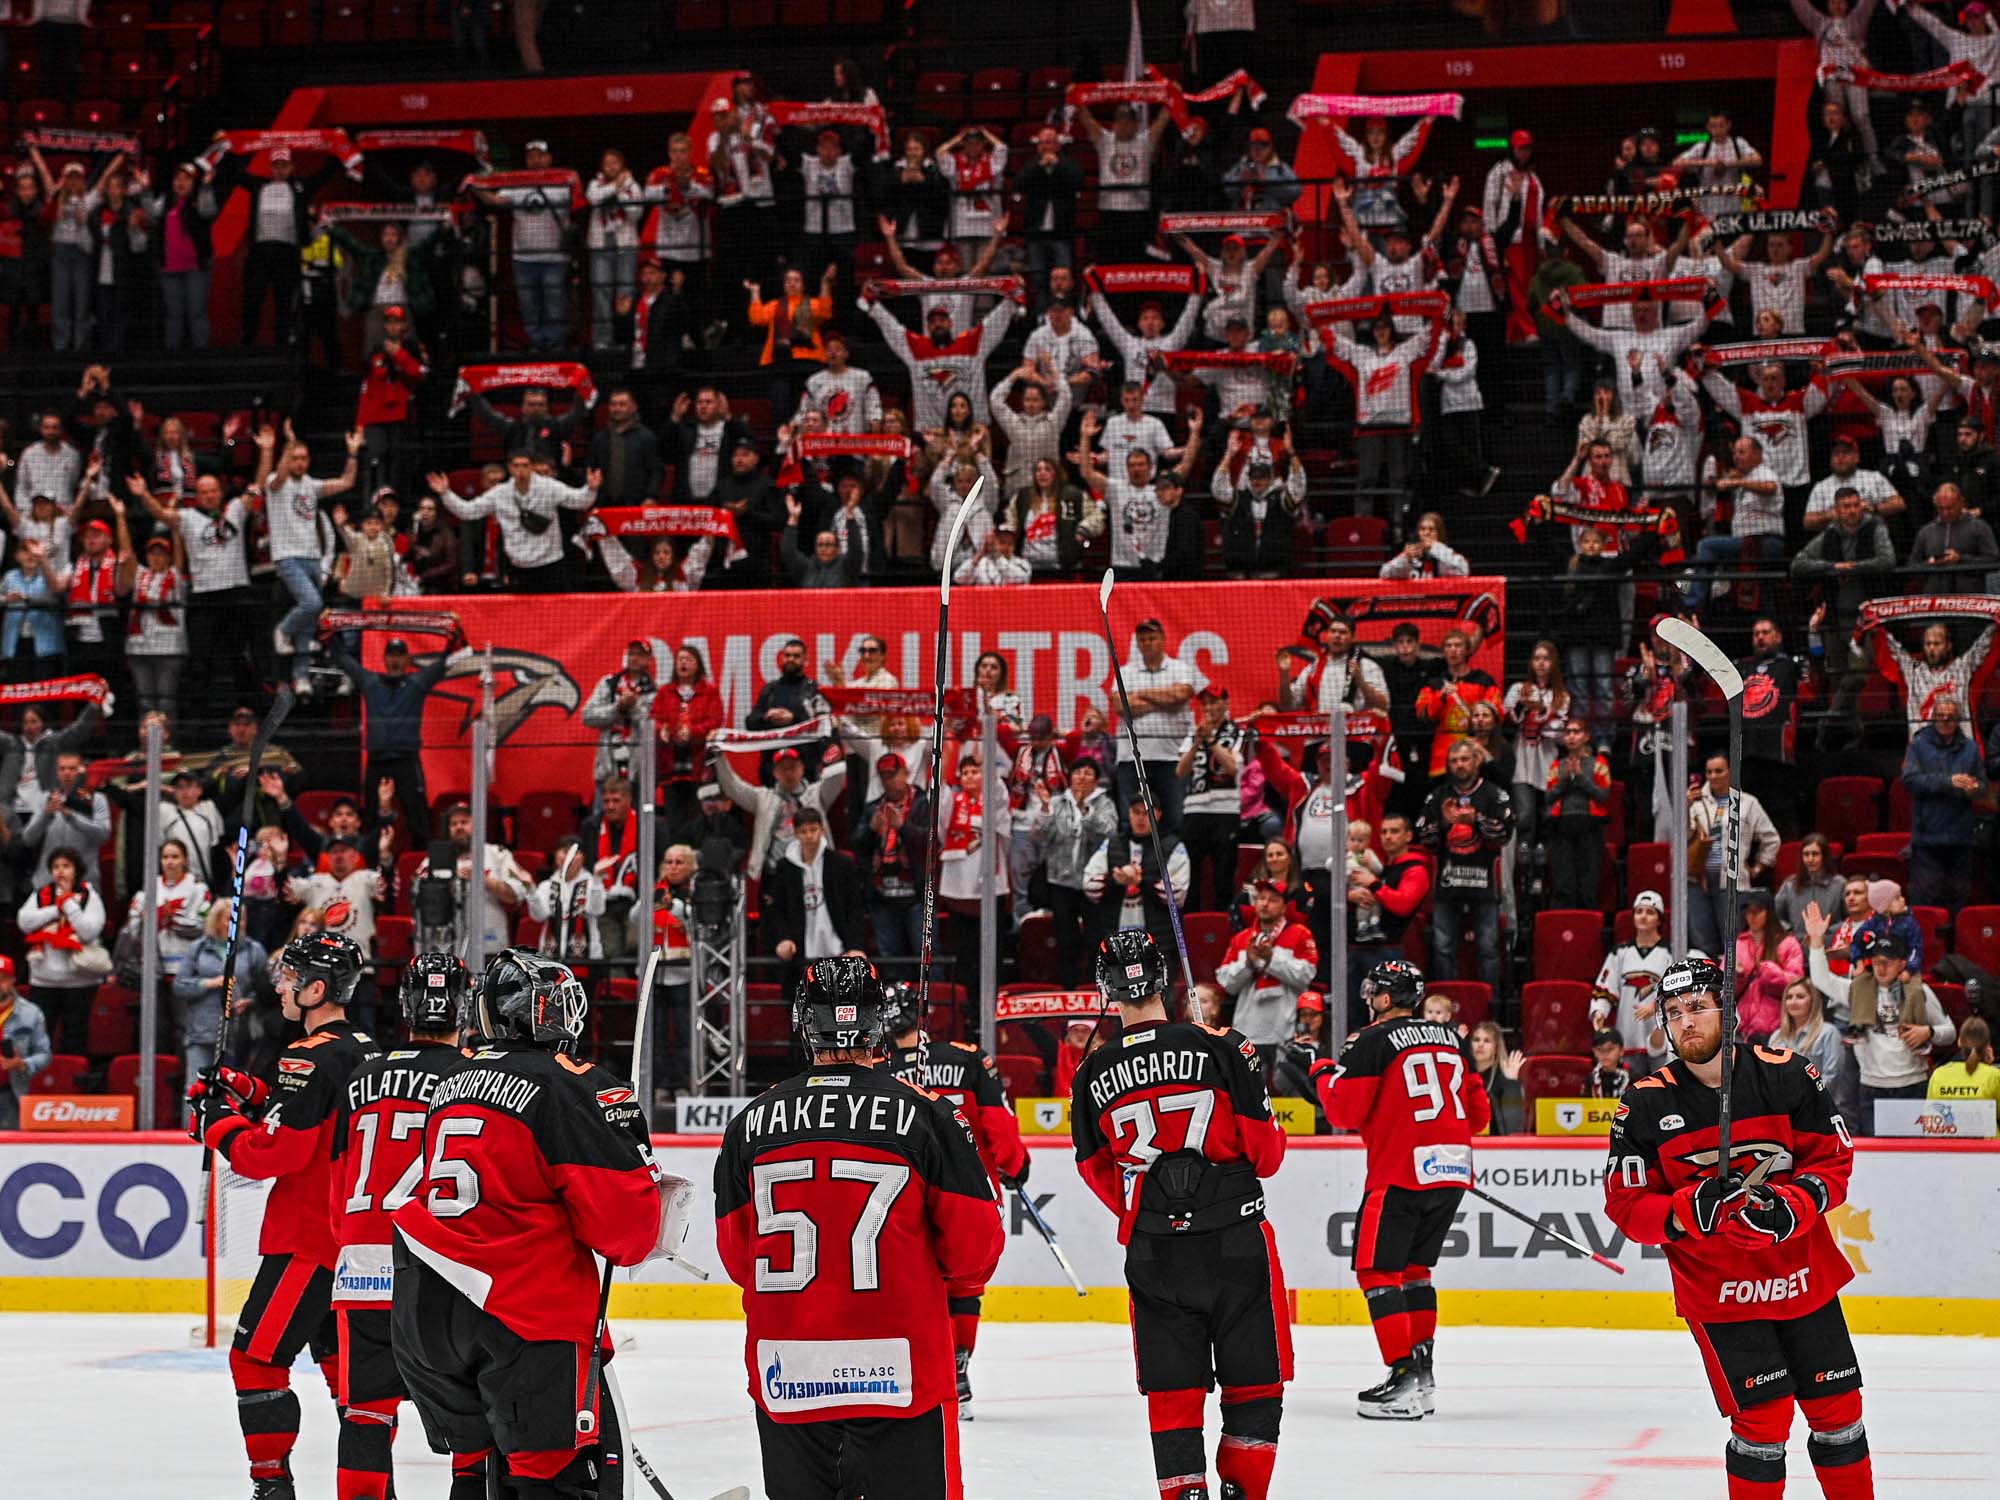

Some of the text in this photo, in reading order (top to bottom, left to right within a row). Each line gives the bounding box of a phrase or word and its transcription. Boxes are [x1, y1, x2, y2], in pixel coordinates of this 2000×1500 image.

[1659, 53, 1686, 69] 110
[1749, 206, 1820, 232] ULTRAS
[902, 631, 1230, 736] ULTRS
[1727, 787, 1741, 880] CCM
[426, 1000, 447, 1014] 12
[1128, 980, 1149, 999] 37
[836, 1006, 856, 1015] FON
[836, 1013, 856, 1022] BET
[836, 1030, 859, 1048] 57
[917, 1029, 930, 1088] CCM
[428, 1069, 541, 1114] ROSKURYAKOV
[1089, 1050, 1209, 1109] REINGARDT
[1402, 1051, 1467, 1123] 97
[1939, 1086, 1980, 1097] SAFETY
[262, 1102, 284, 1136] 4
[744, 1093, 917, 1143] MAKEYEV
[1109, 1087, 1216, 1169] 37
[0, 1161, 208, 1260] СО
[1240, 1197, 1266, 1217] CC
[752, 1159, 911, 1293] 57
[1718, 1267, 1811, 1304] FONBET
[781, 1380, 901, 1400] ГАЗПРОМНЕФТЬ
[832, 1366, 895, 1379] СЕТЬ АЗС
[632, 1443, 656, 1482] CM
